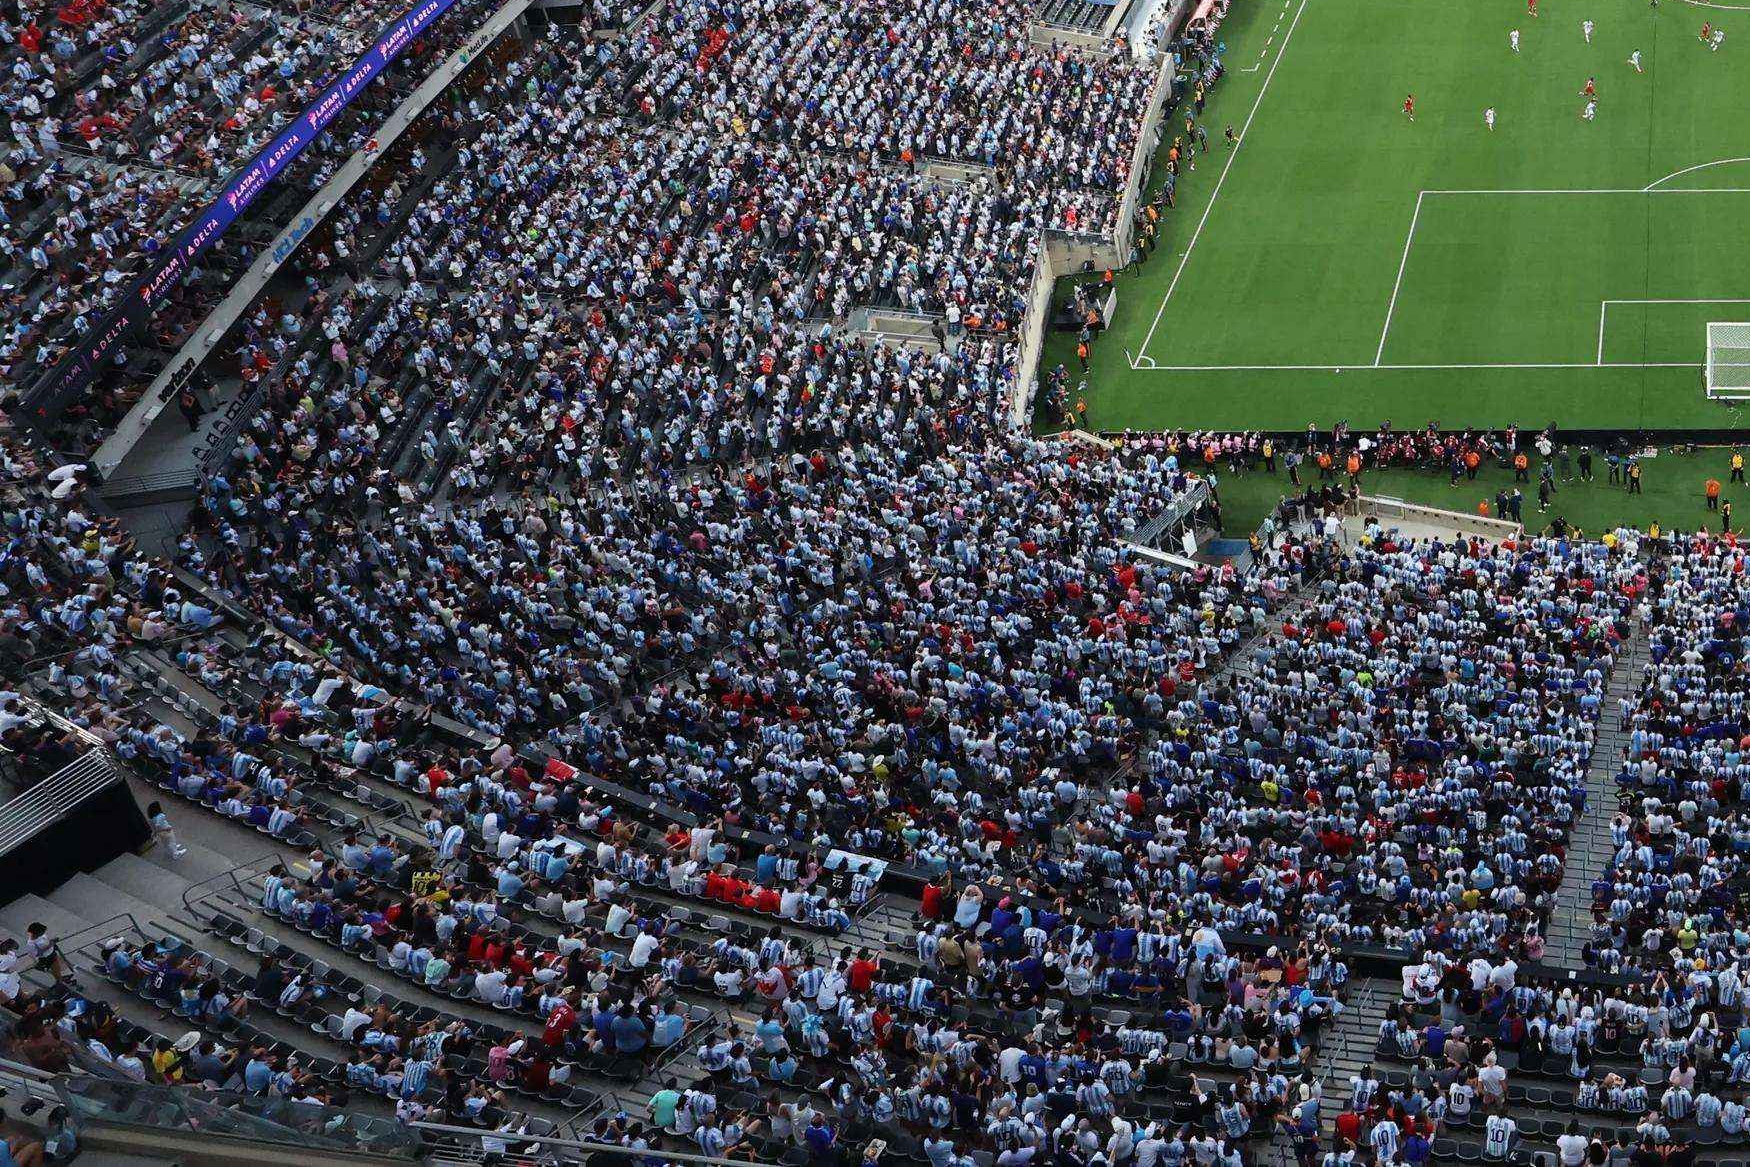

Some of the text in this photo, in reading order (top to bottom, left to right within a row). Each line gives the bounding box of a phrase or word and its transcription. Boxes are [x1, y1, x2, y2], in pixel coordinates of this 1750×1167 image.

[386, 1, 438, 48] LATAM DELTA
[467, 33, 490, 57] MetLife
[316, 64, 372, 117] LATAM DELTA
[235, 134, 300, 197] LATAM DELTA
[150, 219, 219, 291] LATAM DELTA
[99, 316, 130, 349] DELTA
[1027, 934, 1037, 946] 10
[1604, 1027, 1617, 1039] 10
[1356, 1090, 1367, 1104] 10
[1453, 1091, 1465, 1105] 10
[1378, 1129, 1389, 1147] 10
[1490, 1128, 1505, 1143] 10
